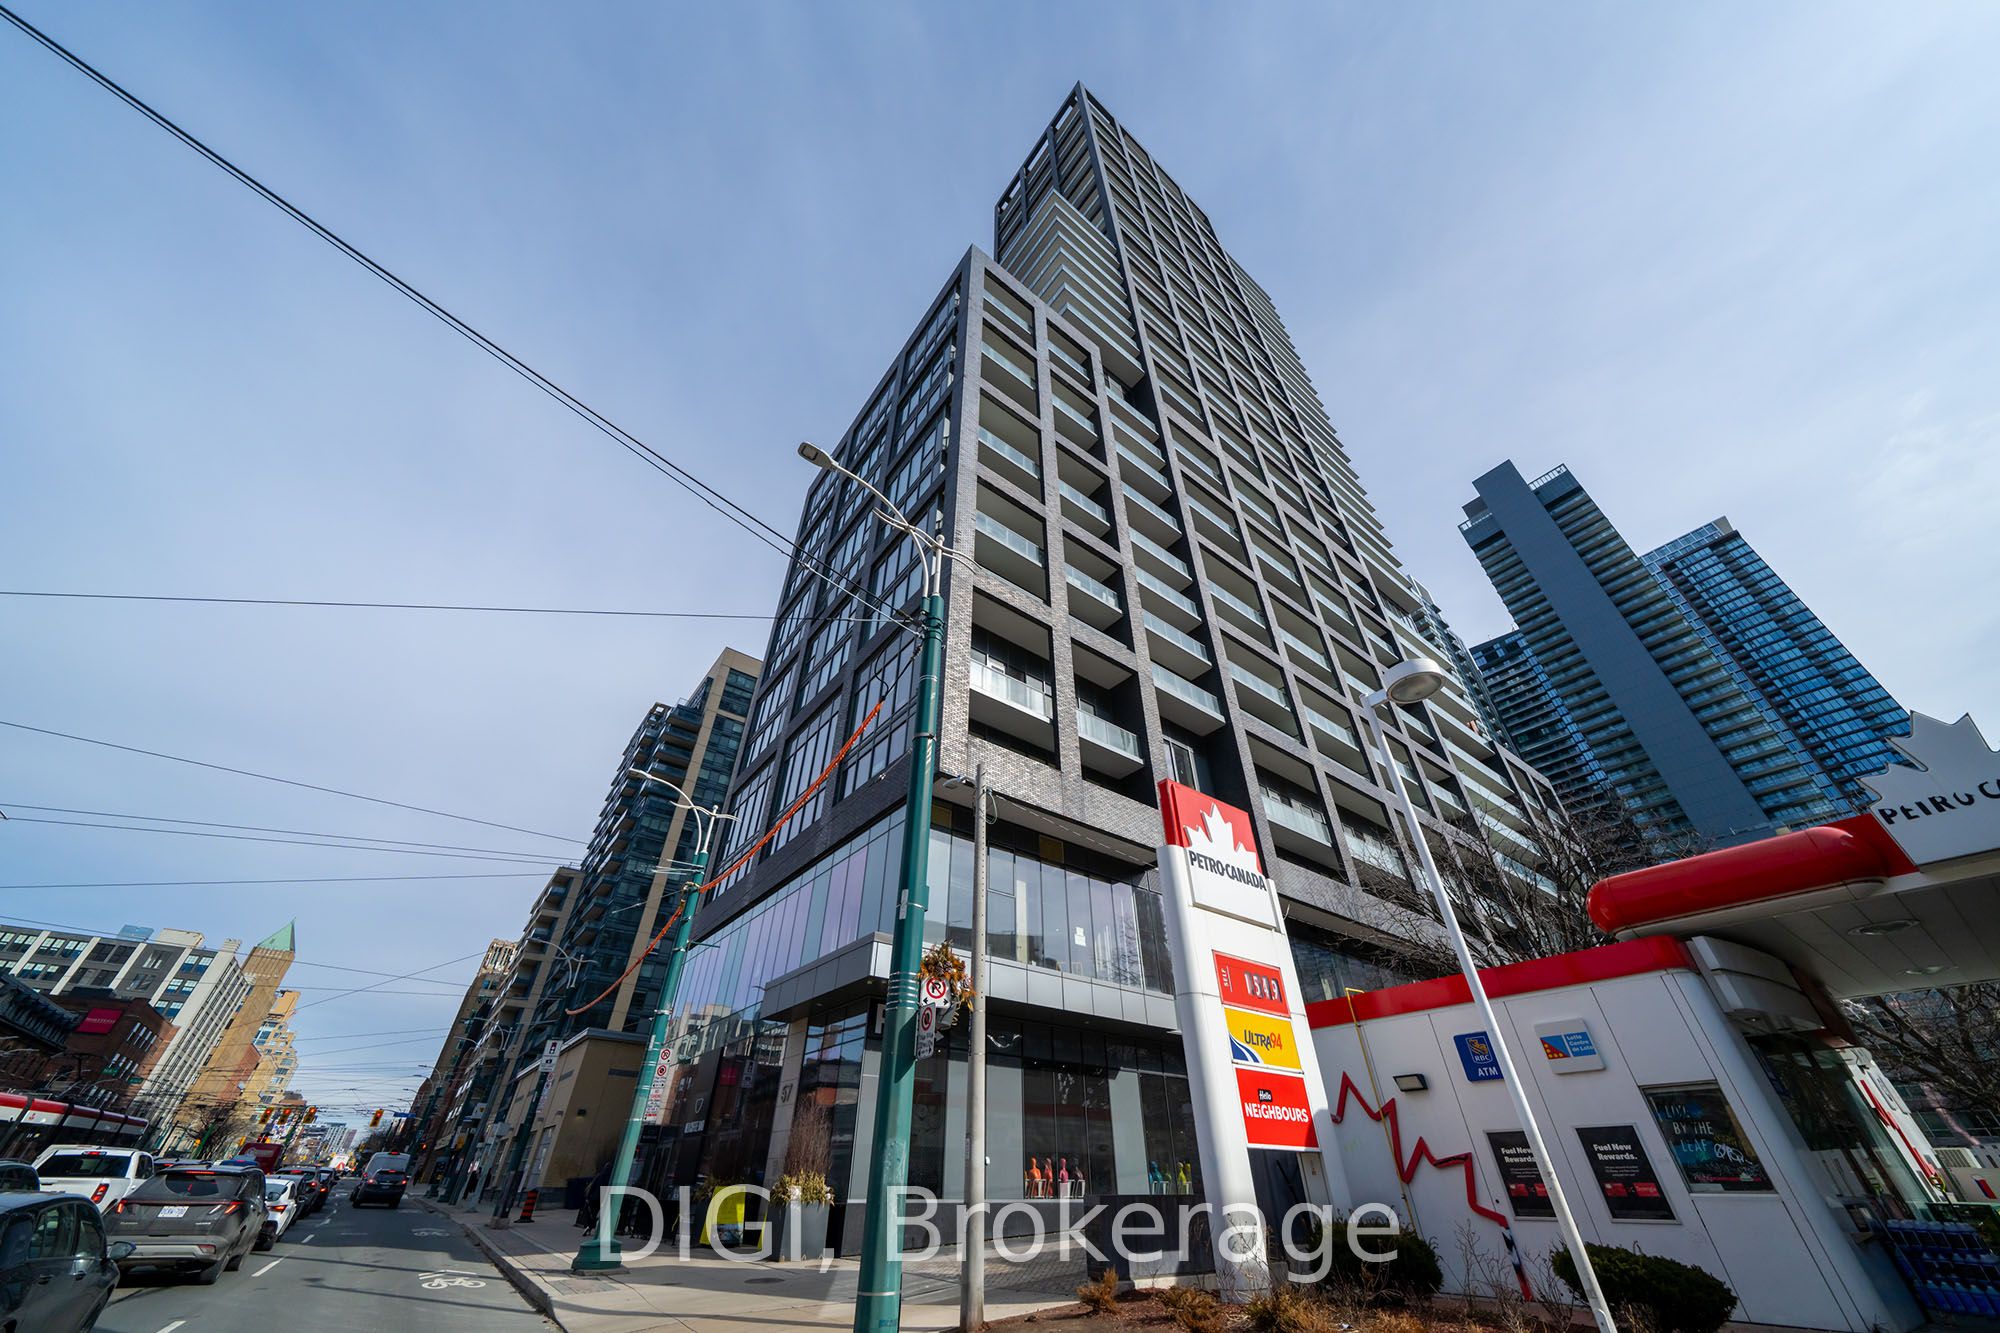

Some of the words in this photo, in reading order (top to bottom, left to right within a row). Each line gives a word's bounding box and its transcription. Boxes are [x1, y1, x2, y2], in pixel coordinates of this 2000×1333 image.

[1474, 1054, 1490, 1062] RBC
[1478, 1066, 1499, 1077] ATM
[1258, 1090, 1272, 1101] Hello
[1672, 1121, 1687, 1135] BY
[1692, 1121, 1714, 1135] THE
[1592, 1143, 1612, 1151] Fuel
[1611, 1143, 1632, 1151] New
[1680, 1139, 1707, 1152] LEAF
[1500, 1147, 1517, 1155] Fuel
[1597, 1152, 1638, 1160] Rewards.
